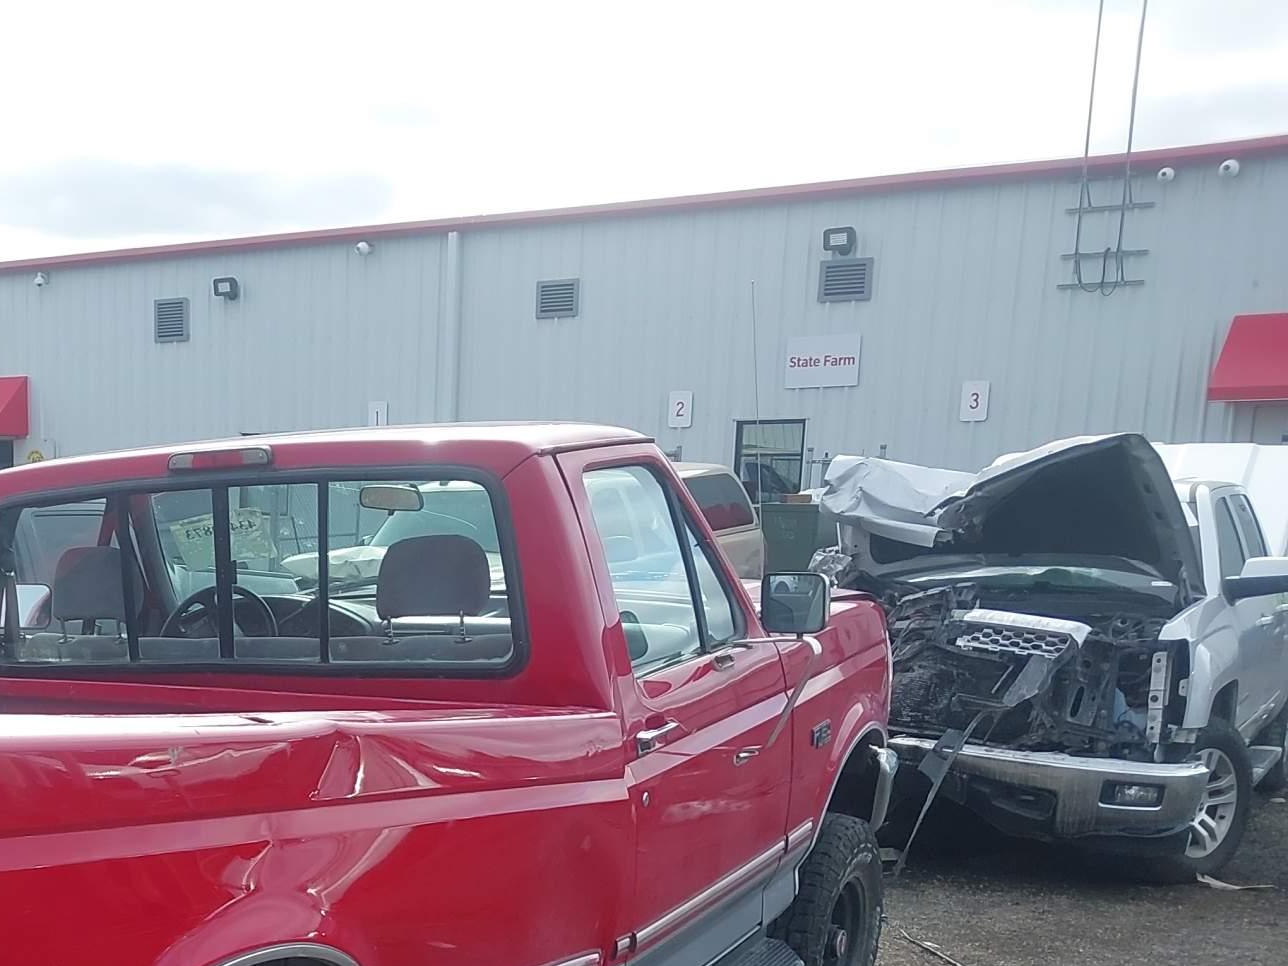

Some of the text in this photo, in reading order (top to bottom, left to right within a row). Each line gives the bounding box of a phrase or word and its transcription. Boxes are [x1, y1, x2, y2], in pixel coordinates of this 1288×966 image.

[788, 354, 856, 368] State Farm
[969, 392, 980, 409] 3
[675, 401, 685, 417] 2
